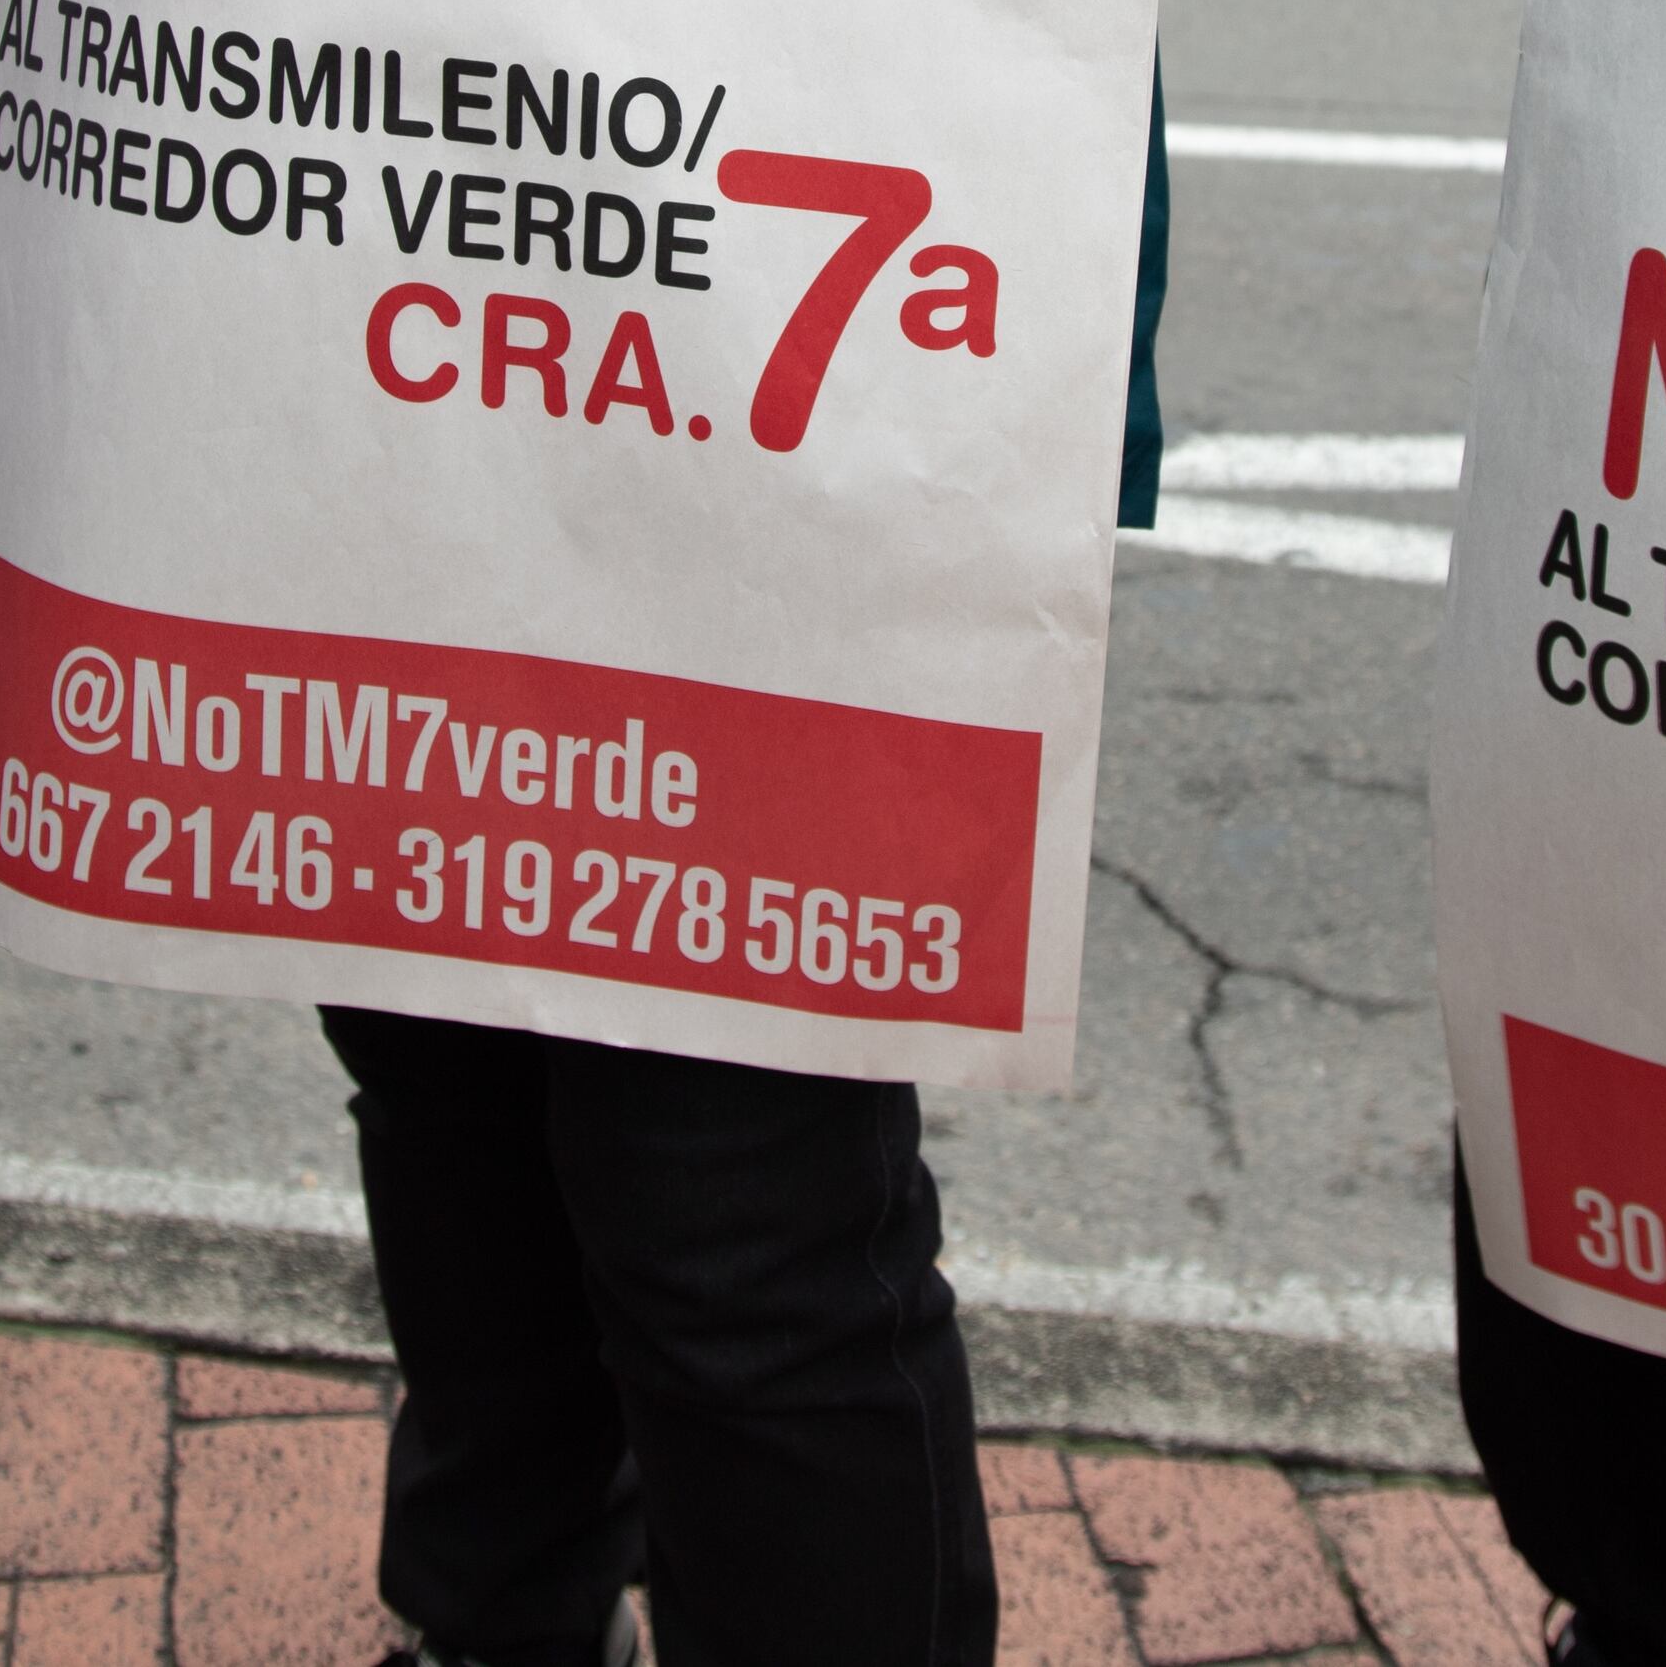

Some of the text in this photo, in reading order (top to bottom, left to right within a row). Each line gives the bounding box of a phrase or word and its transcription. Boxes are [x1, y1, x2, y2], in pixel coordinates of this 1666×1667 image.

[58, 4, 726, 172] TRANSMILENIO/
[382, 166, 715, 291] VERDE
[367, 283, 711, 441] CRA.
[1540, 509, 1631, 617] AL
[52, 647, 697, 827] @NoTM7verde
[0, 758, 110, 882] 667
[125, 798, 332, 910] 2146
[397, 828, 552, 936] 319
[569, 850, 726, 962] 278
[745, 877, 961, 993] 5653
